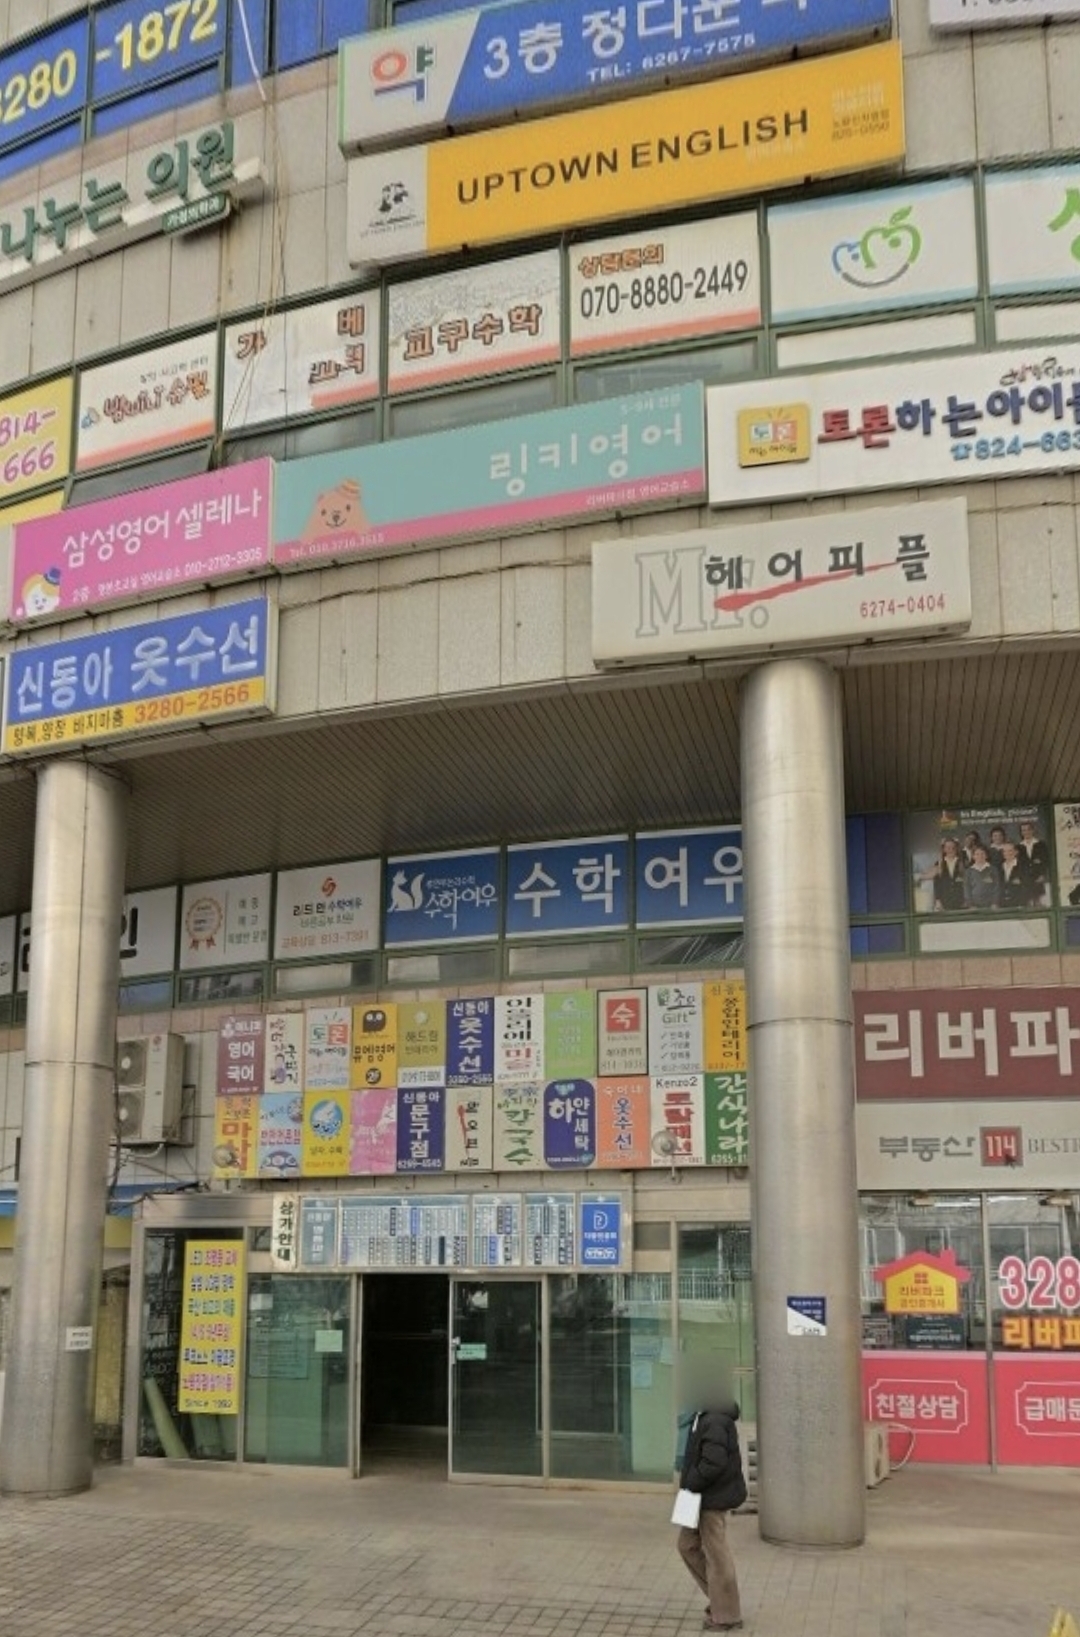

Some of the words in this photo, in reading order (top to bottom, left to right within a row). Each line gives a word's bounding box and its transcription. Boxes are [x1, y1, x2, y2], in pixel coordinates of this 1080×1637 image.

[372, 45, 434, 102] 약
[483, 21, 563, 79] 3층
[586, 62, 632, 83] TEL:
[0, 49, 76, 123] 280
[457, 148, 618, 204] UPTOWN
[631, 109, 809, 169] ENGLISH
[1, 179, 129, 262] 나누는
[146, 120, 235, 203] 의원
[580, 259, 748, 319] 070-8880-2449
[404, 303, 542, 361] 교구수학
[490, 413, 683, 497] 링키영어
[62, 510, 170, 569] 삼성영어
[176, 488, 262, 541] 셀레나
[704, 533, 930, 590] 헤어피플
[859, 593, 946, 619] 6274-0404
[17, 645, 114, 715] 신동아
[130, 614, 259, 693] 옷수선
[133, 683, 250, 724] 3280-2566
[425, 882, 498, 931] 수학여우
[453, 1001, 490, 1017] 신동아
[661, 1012, 689, 1025] Gift
[228, 1041, 255, 1059] 영어
[458, 1017, 483, 1073] 옷수선
[863, 1006, 1080, 1078] 리버파
[226, 1064, 255, 1083] 국어
[655, 1076, 699, 1089] Kenzo2
[409, 1104, 431, 1159] 문구점
[613, 1098, 633, 1151] 옷수선
[878, 1135, 977, 1163] 부동산
[985, 1135, 1017, 1158] 114
[1000, 1256, 1080, 1309] 328
[875, 1392, 960, 1420] 친절상담
